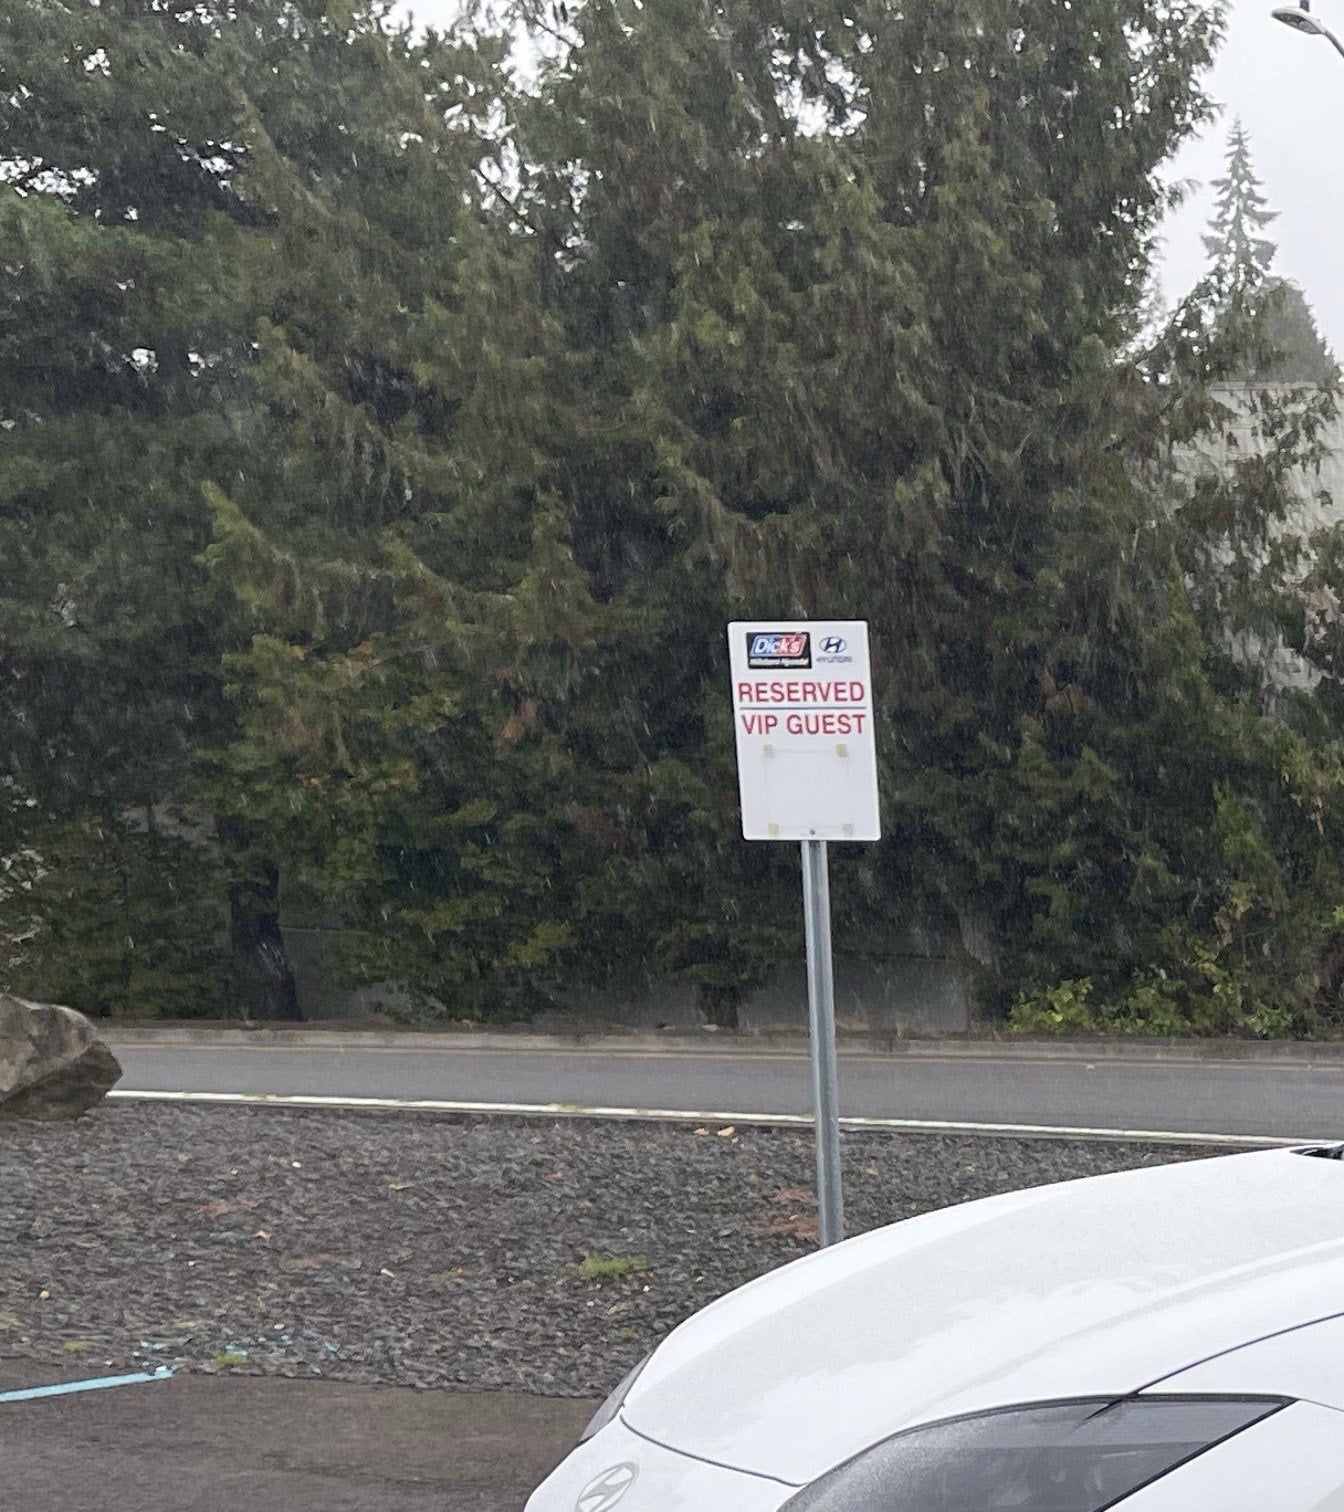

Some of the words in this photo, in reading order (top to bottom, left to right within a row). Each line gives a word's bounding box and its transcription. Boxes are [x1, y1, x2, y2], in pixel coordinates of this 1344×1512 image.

[738, 681, 865, 703] RESERVED
[741, 714, 778, 735] VIP
[786, 714, 866, 735] GUEST
